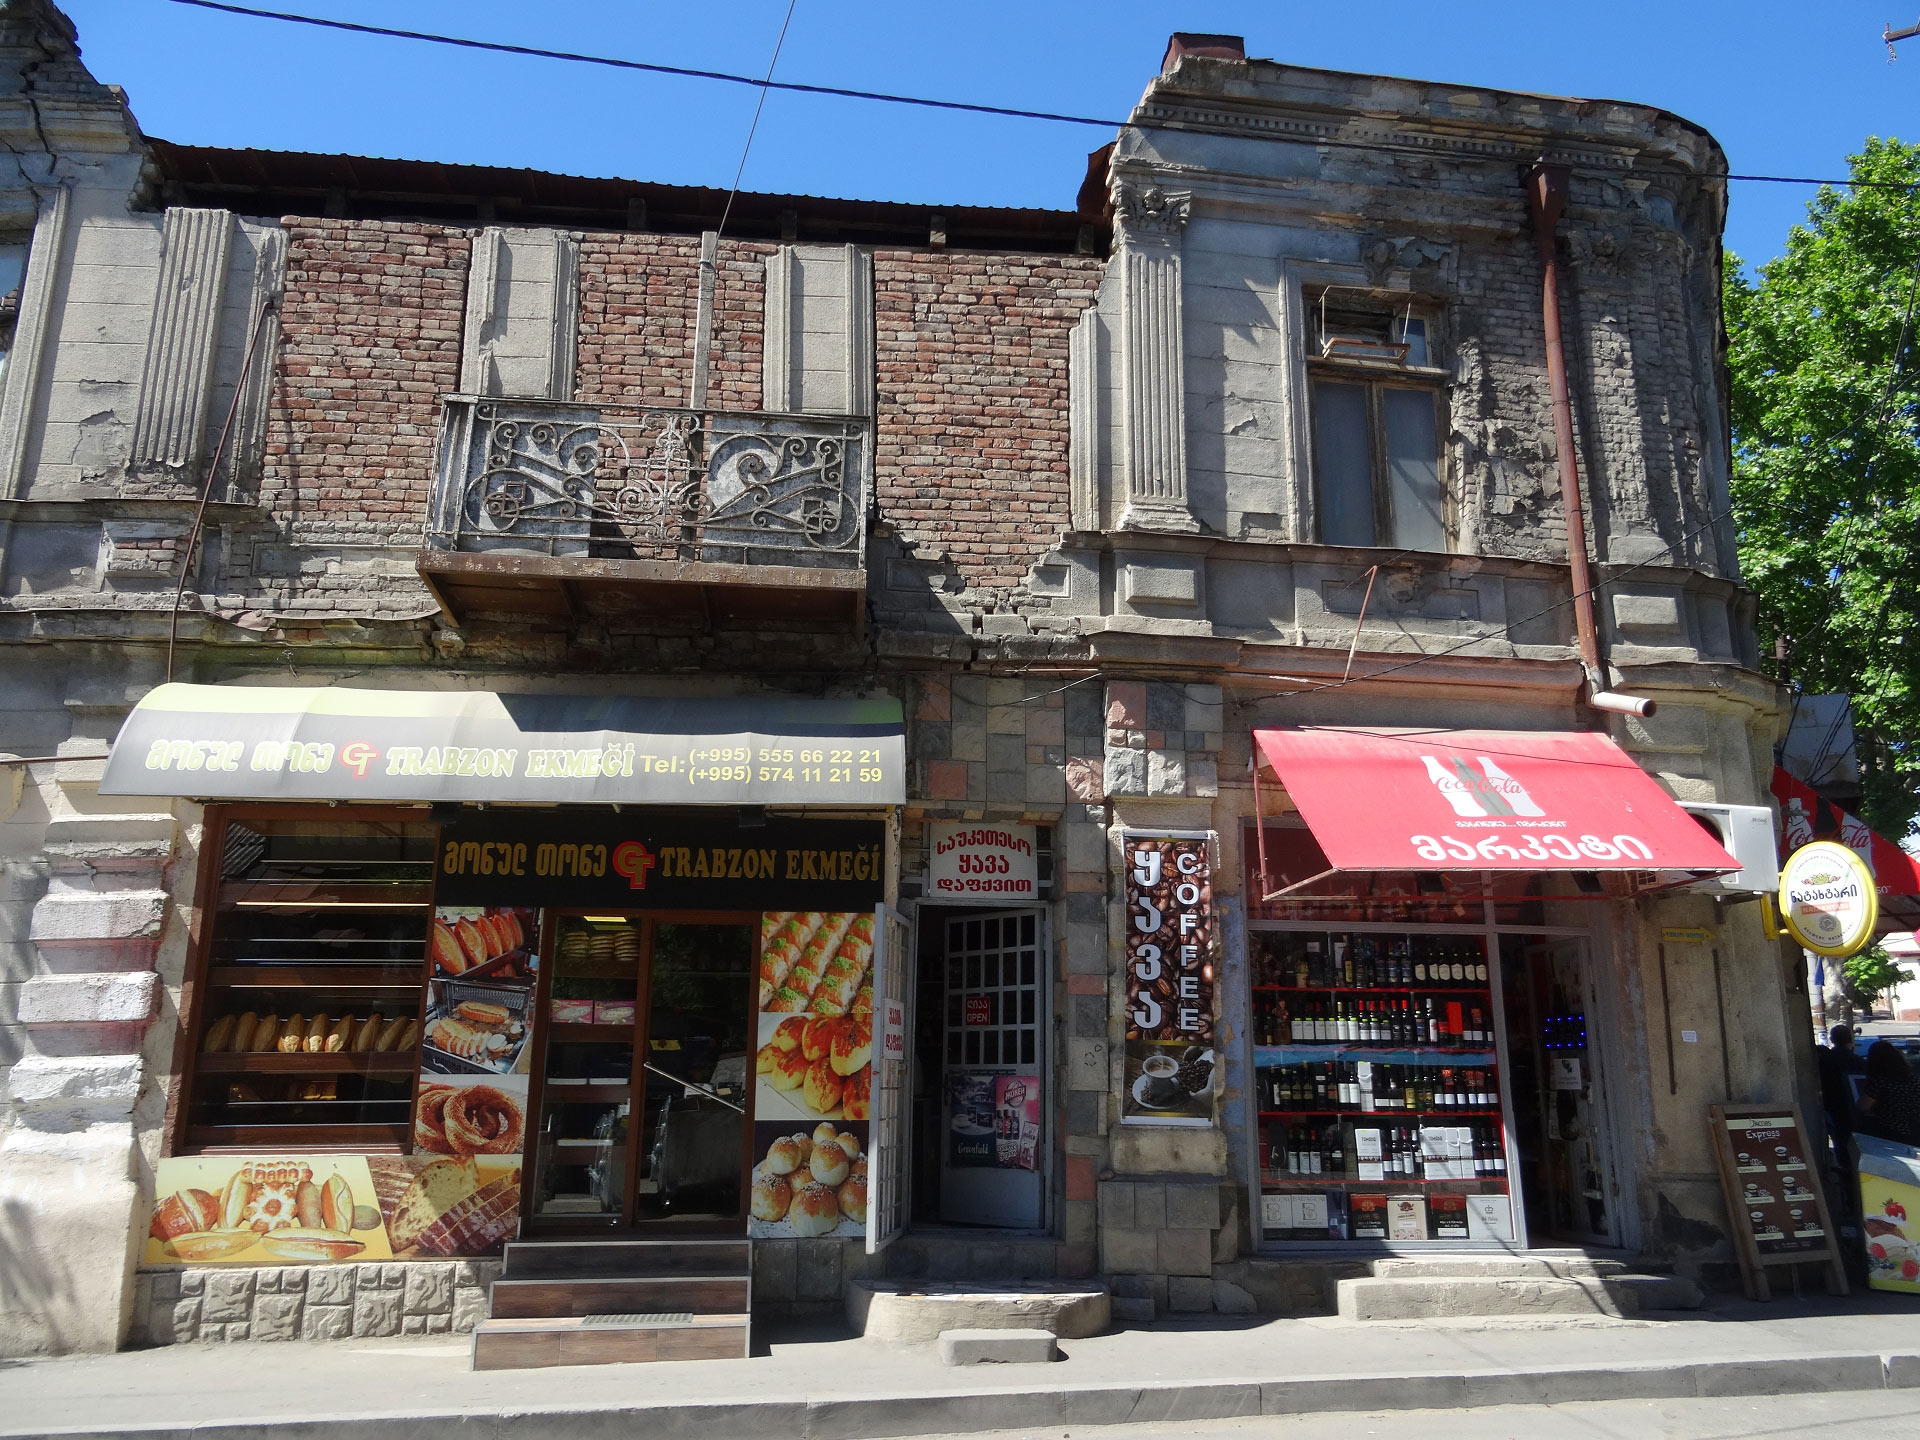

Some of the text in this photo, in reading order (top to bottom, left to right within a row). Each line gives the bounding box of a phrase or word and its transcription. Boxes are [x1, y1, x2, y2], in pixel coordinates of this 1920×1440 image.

[251, 741, 335, 773] თონე
[386, 747, 518, 777] TRABZON
[525, 743, 635, 777] EKMEĞİ
[640, 755, 686, 773] Tel:
[689, 747, 881, 765] (+995) 555 66 22 21
[688, 765, 882, 784] (+995) 574 11 21 59
[937, 829, 1031, 857] საუკეთესო
[1410, 834, 1654, 861] მარკეტი
[535, 843, 607, 877] თონე
[660, 846, 777, 879] TRABZON
[785, 843, 881, 881] EKMEĞİ
[959, 854, 1010, 874] ყავა
[1790, 884, 1858, 903] ნატახტარი
[1176, 852, 1199, 1031] COFFEE
[967, 1013, 988, 1023] OPEN
[1751, 1120, 1772, 1128] JACOBS
[1746, 1130, 1780, 1143] Express
[957, 1142, 989, 1154] Greenfield
